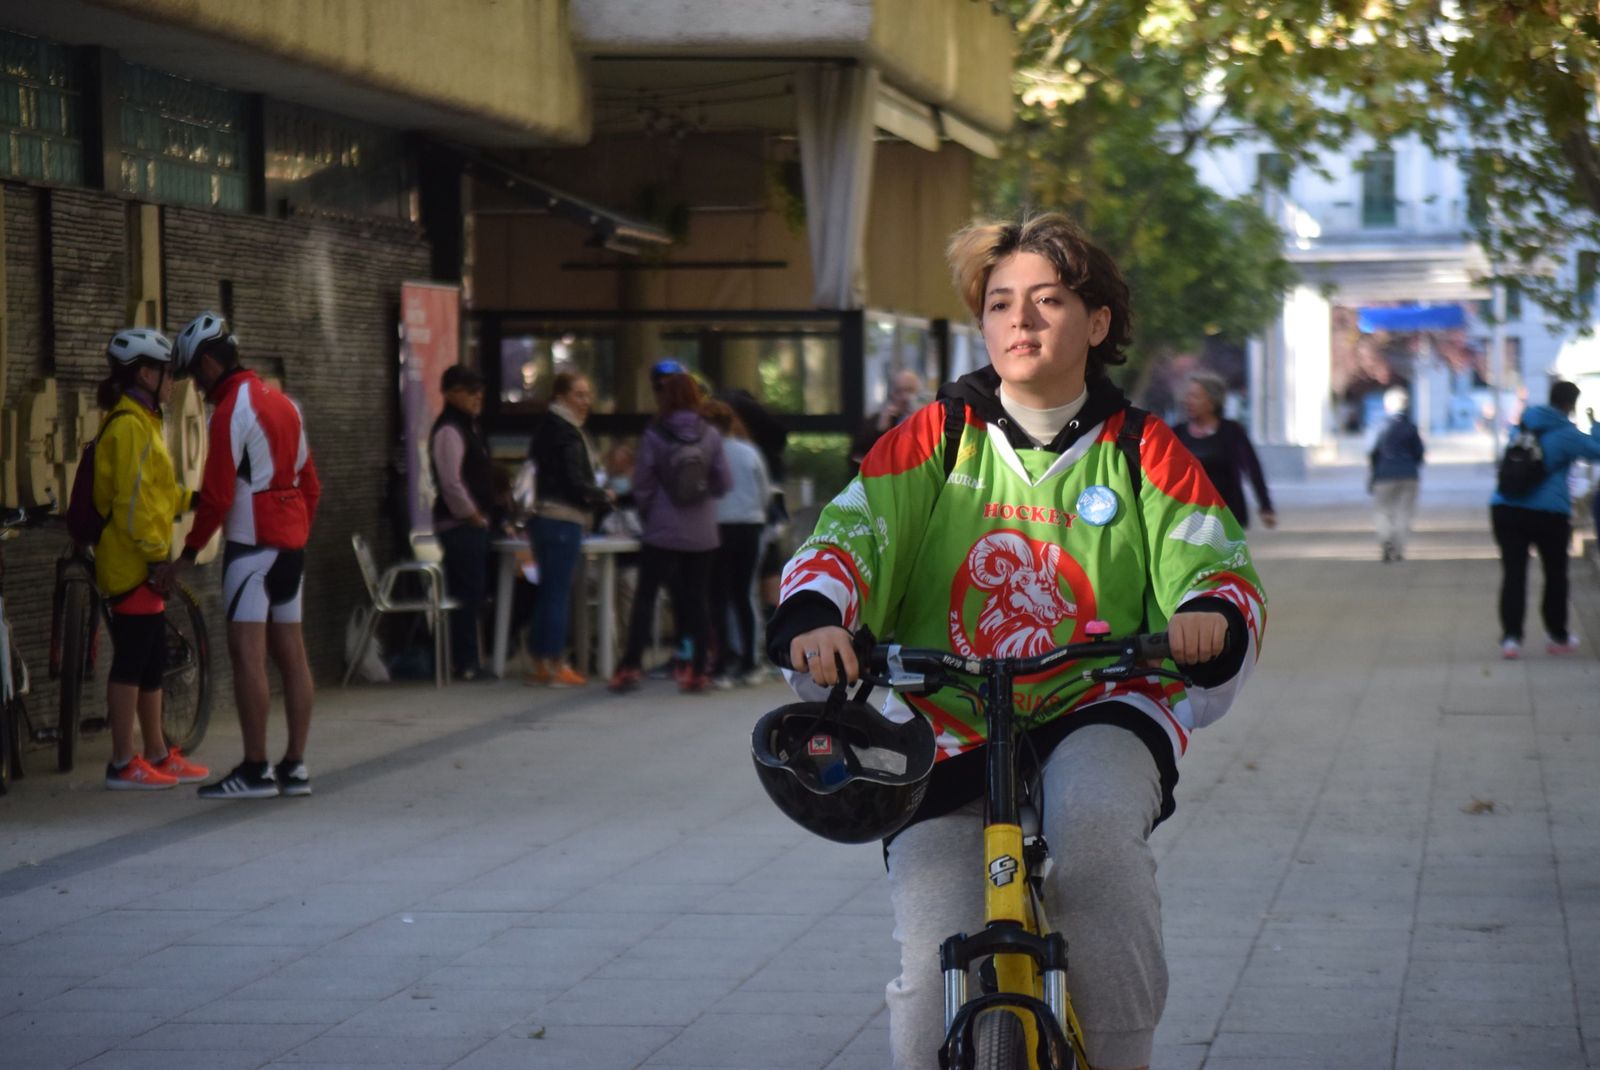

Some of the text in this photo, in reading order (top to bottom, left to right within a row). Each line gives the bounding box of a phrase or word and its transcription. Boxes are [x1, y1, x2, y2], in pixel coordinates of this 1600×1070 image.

[947, 472, 985, 489] RURAL
[983, 503, 1077, 529] HOCKEY
[990, 856, 1016, 887] GT
